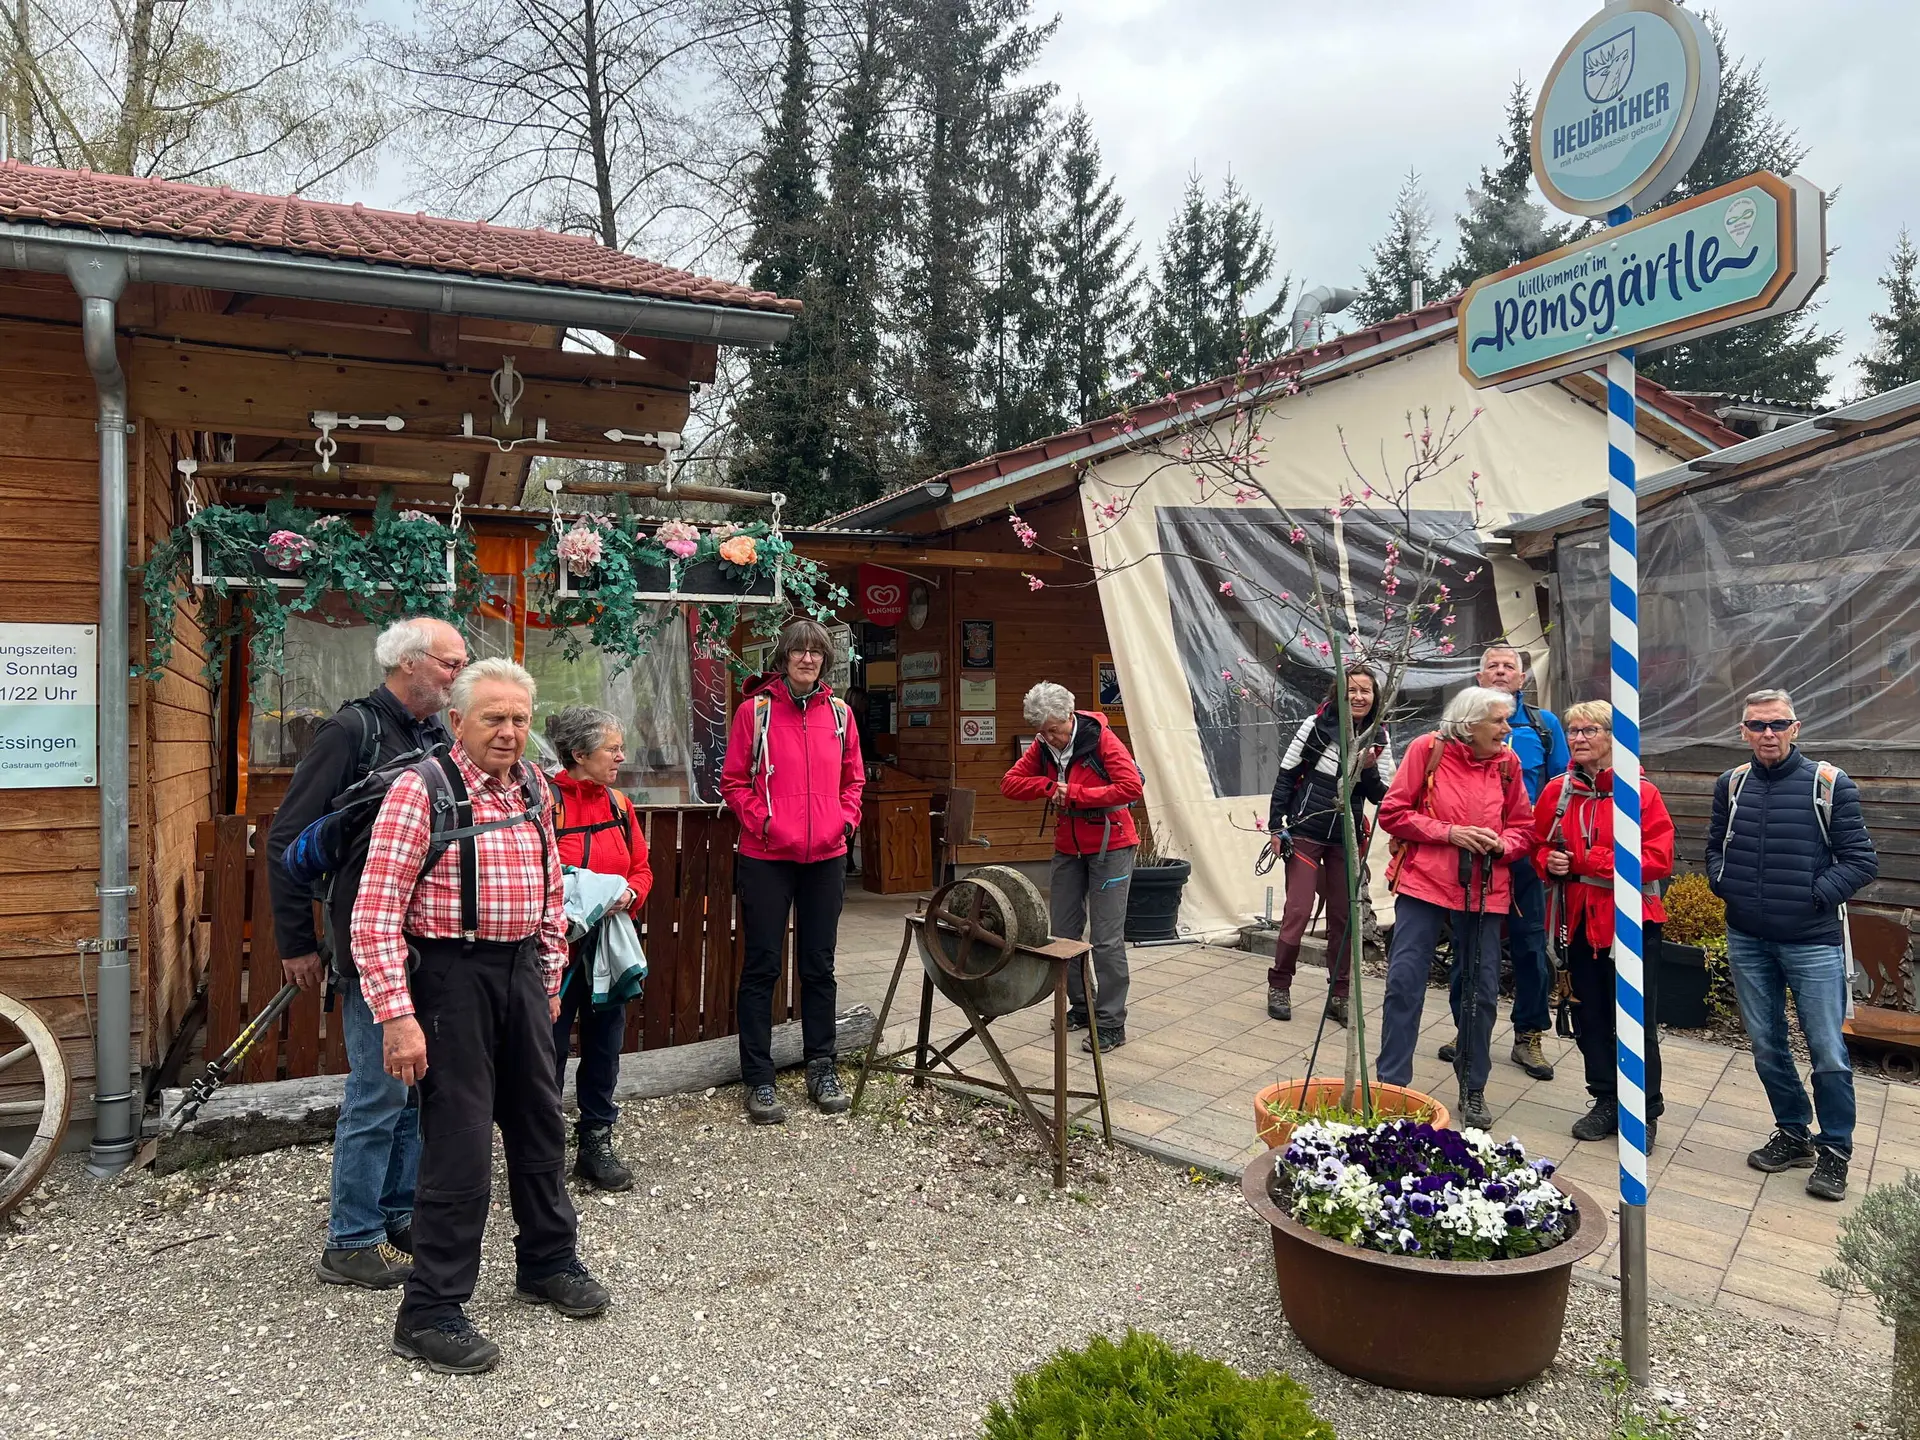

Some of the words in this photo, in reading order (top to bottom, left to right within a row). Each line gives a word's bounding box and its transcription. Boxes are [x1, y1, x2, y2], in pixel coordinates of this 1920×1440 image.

[1553, 82, 1669, 160] HEUBACHER
[1560, 157, 1573, 168] mit
[1573, 134, 1629, 163] Albquellwasser
[1630, 118, 1662, 141] gebraut
[1592, 255, 1607, 273] im
[1471, 229, 1759, 353] Remsgärtle
[867, 606, 902, 615] LANGNESE
[0, 645, 76, 657] ungszeiten:
[6, 661, 78, 679] Sonntag
[0, 686, 37, 701] 1/22
[44, 686, 78, 701] Uhr
[1, 761, 42, 769] Gastraum
[44, 760, 78, 769] geöffnet
